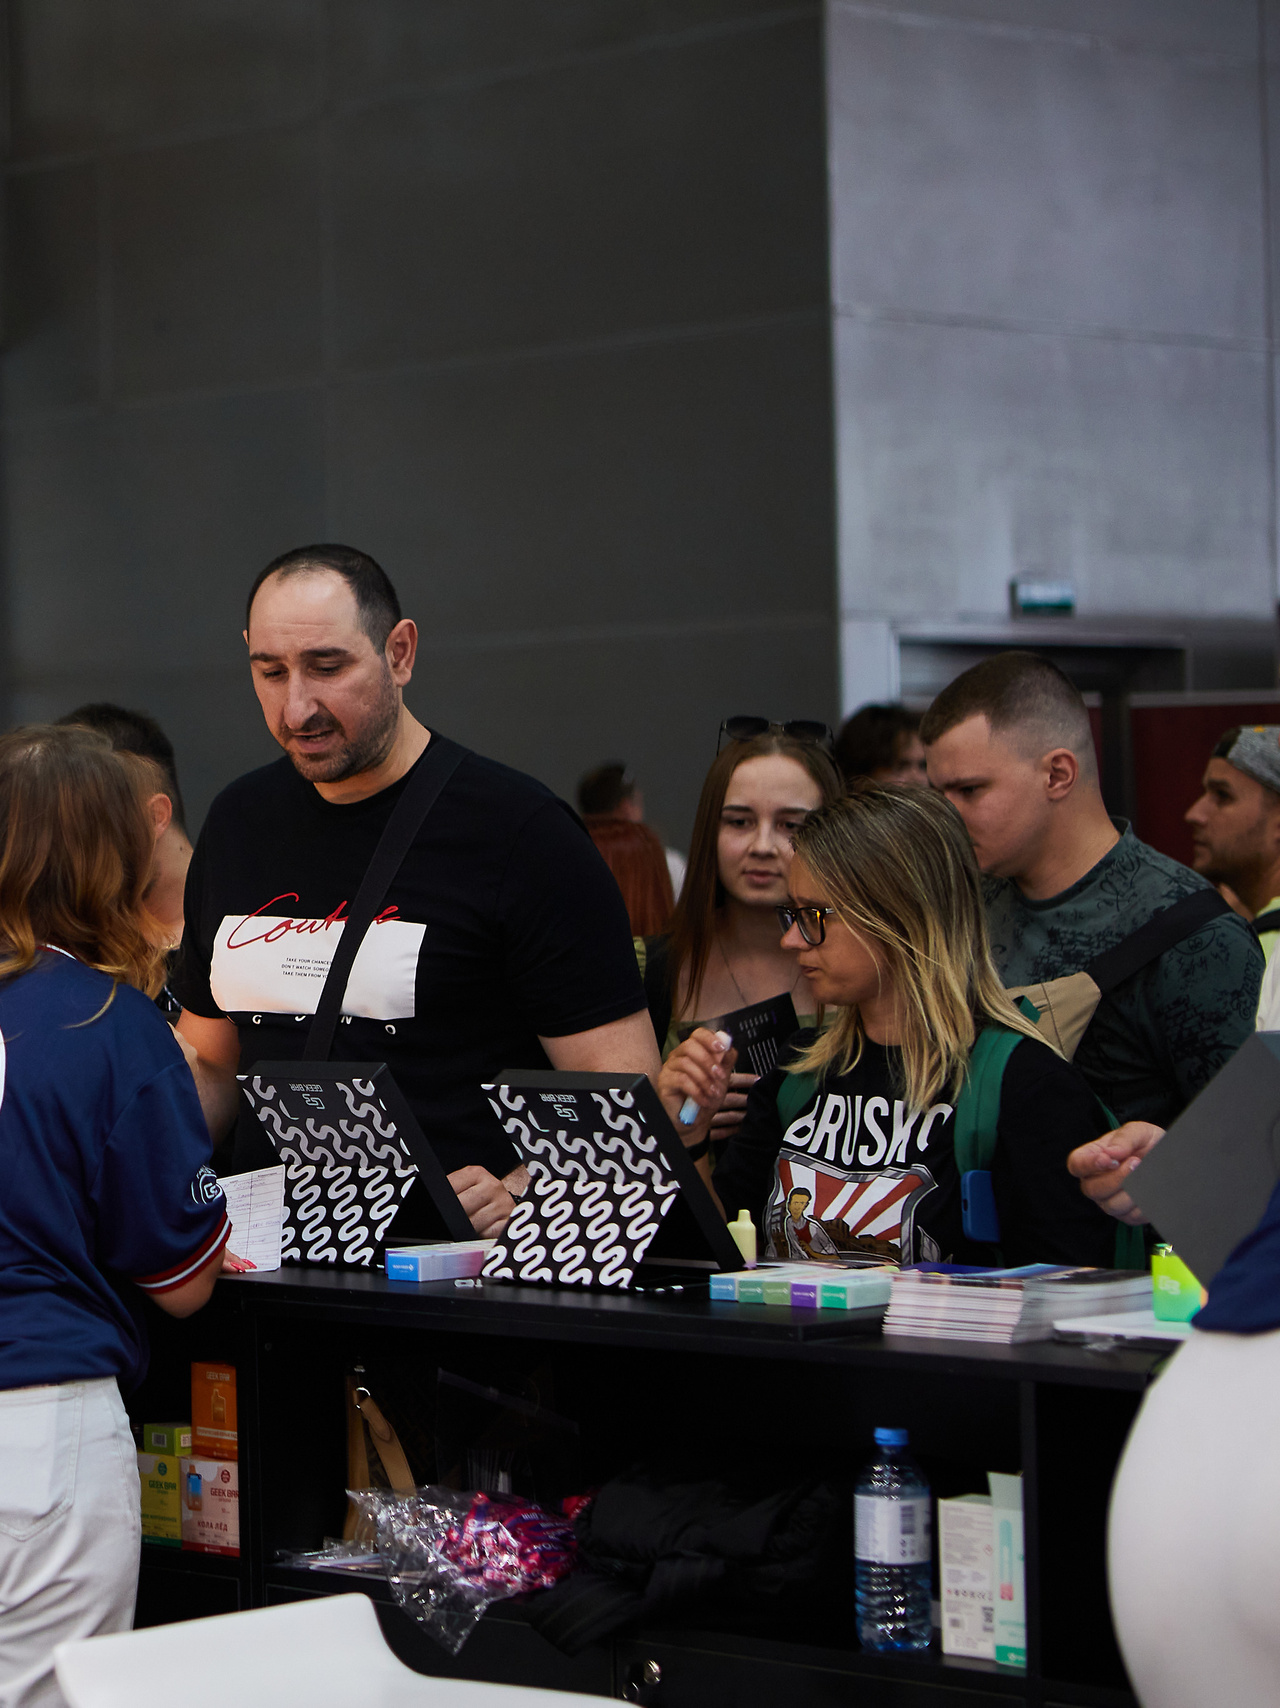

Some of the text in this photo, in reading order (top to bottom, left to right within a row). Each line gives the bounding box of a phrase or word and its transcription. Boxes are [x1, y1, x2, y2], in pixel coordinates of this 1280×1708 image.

[148, 1480, 164, 1489] GEEK
[210, 1487, 226, 1498] GEEK
[197, 1520, 214, 1530] КОЛА
